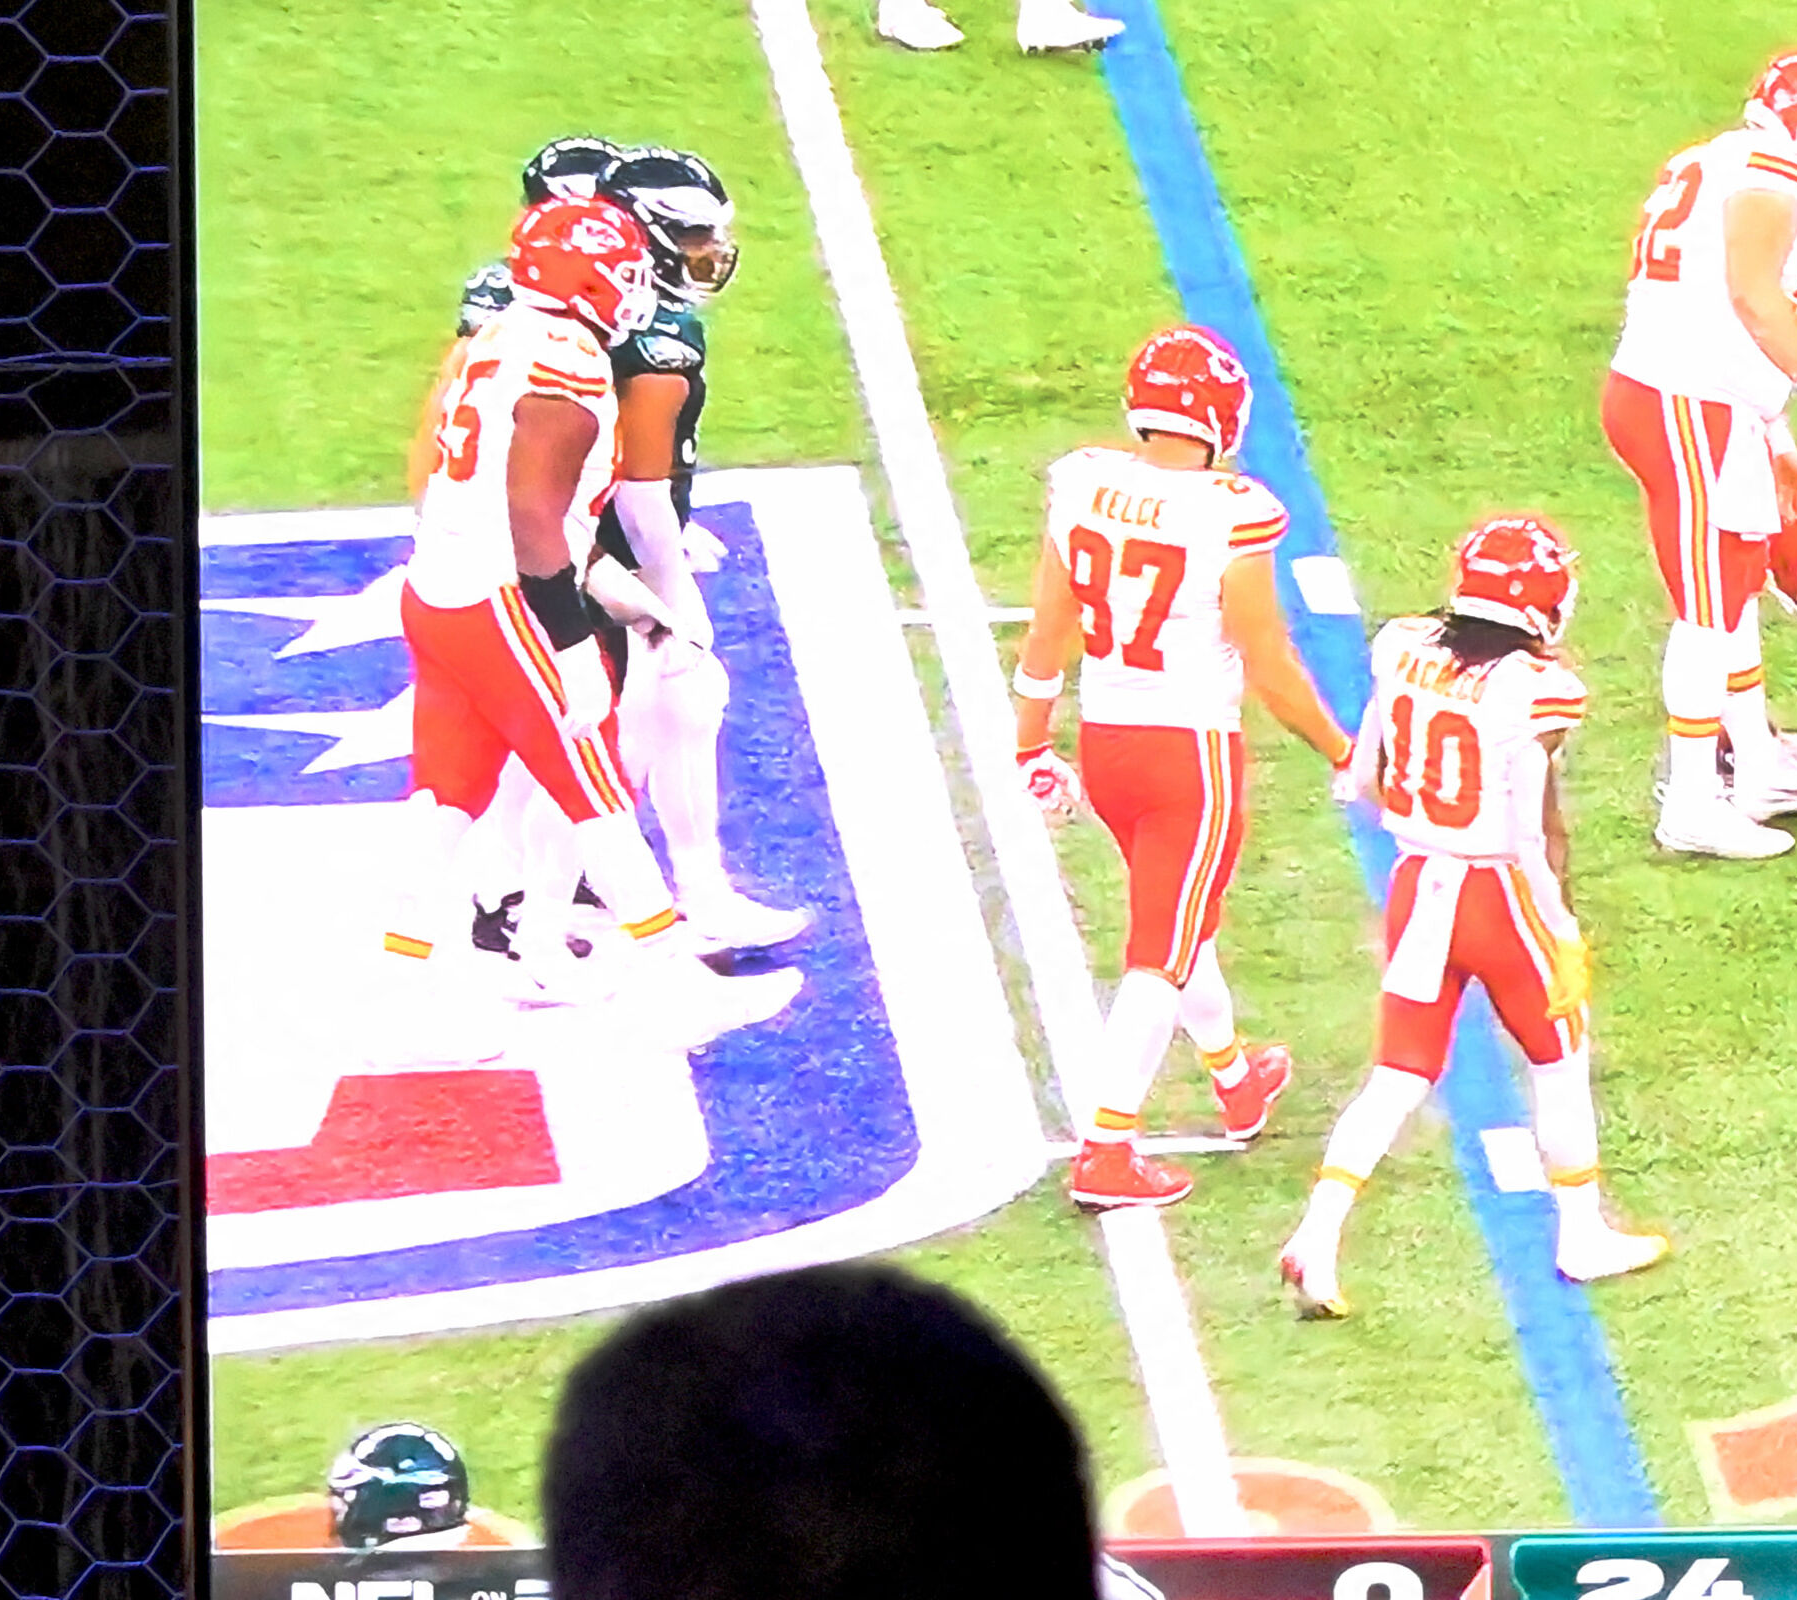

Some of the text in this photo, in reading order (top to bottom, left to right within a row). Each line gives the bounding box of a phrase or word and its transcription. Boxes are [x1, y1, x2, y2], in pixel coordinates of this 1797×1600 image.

[1091, 486, 1168, 530] KELCE
[1069, 523, 1187, 672] 87
[1386, 693, 1483, 829] 10
